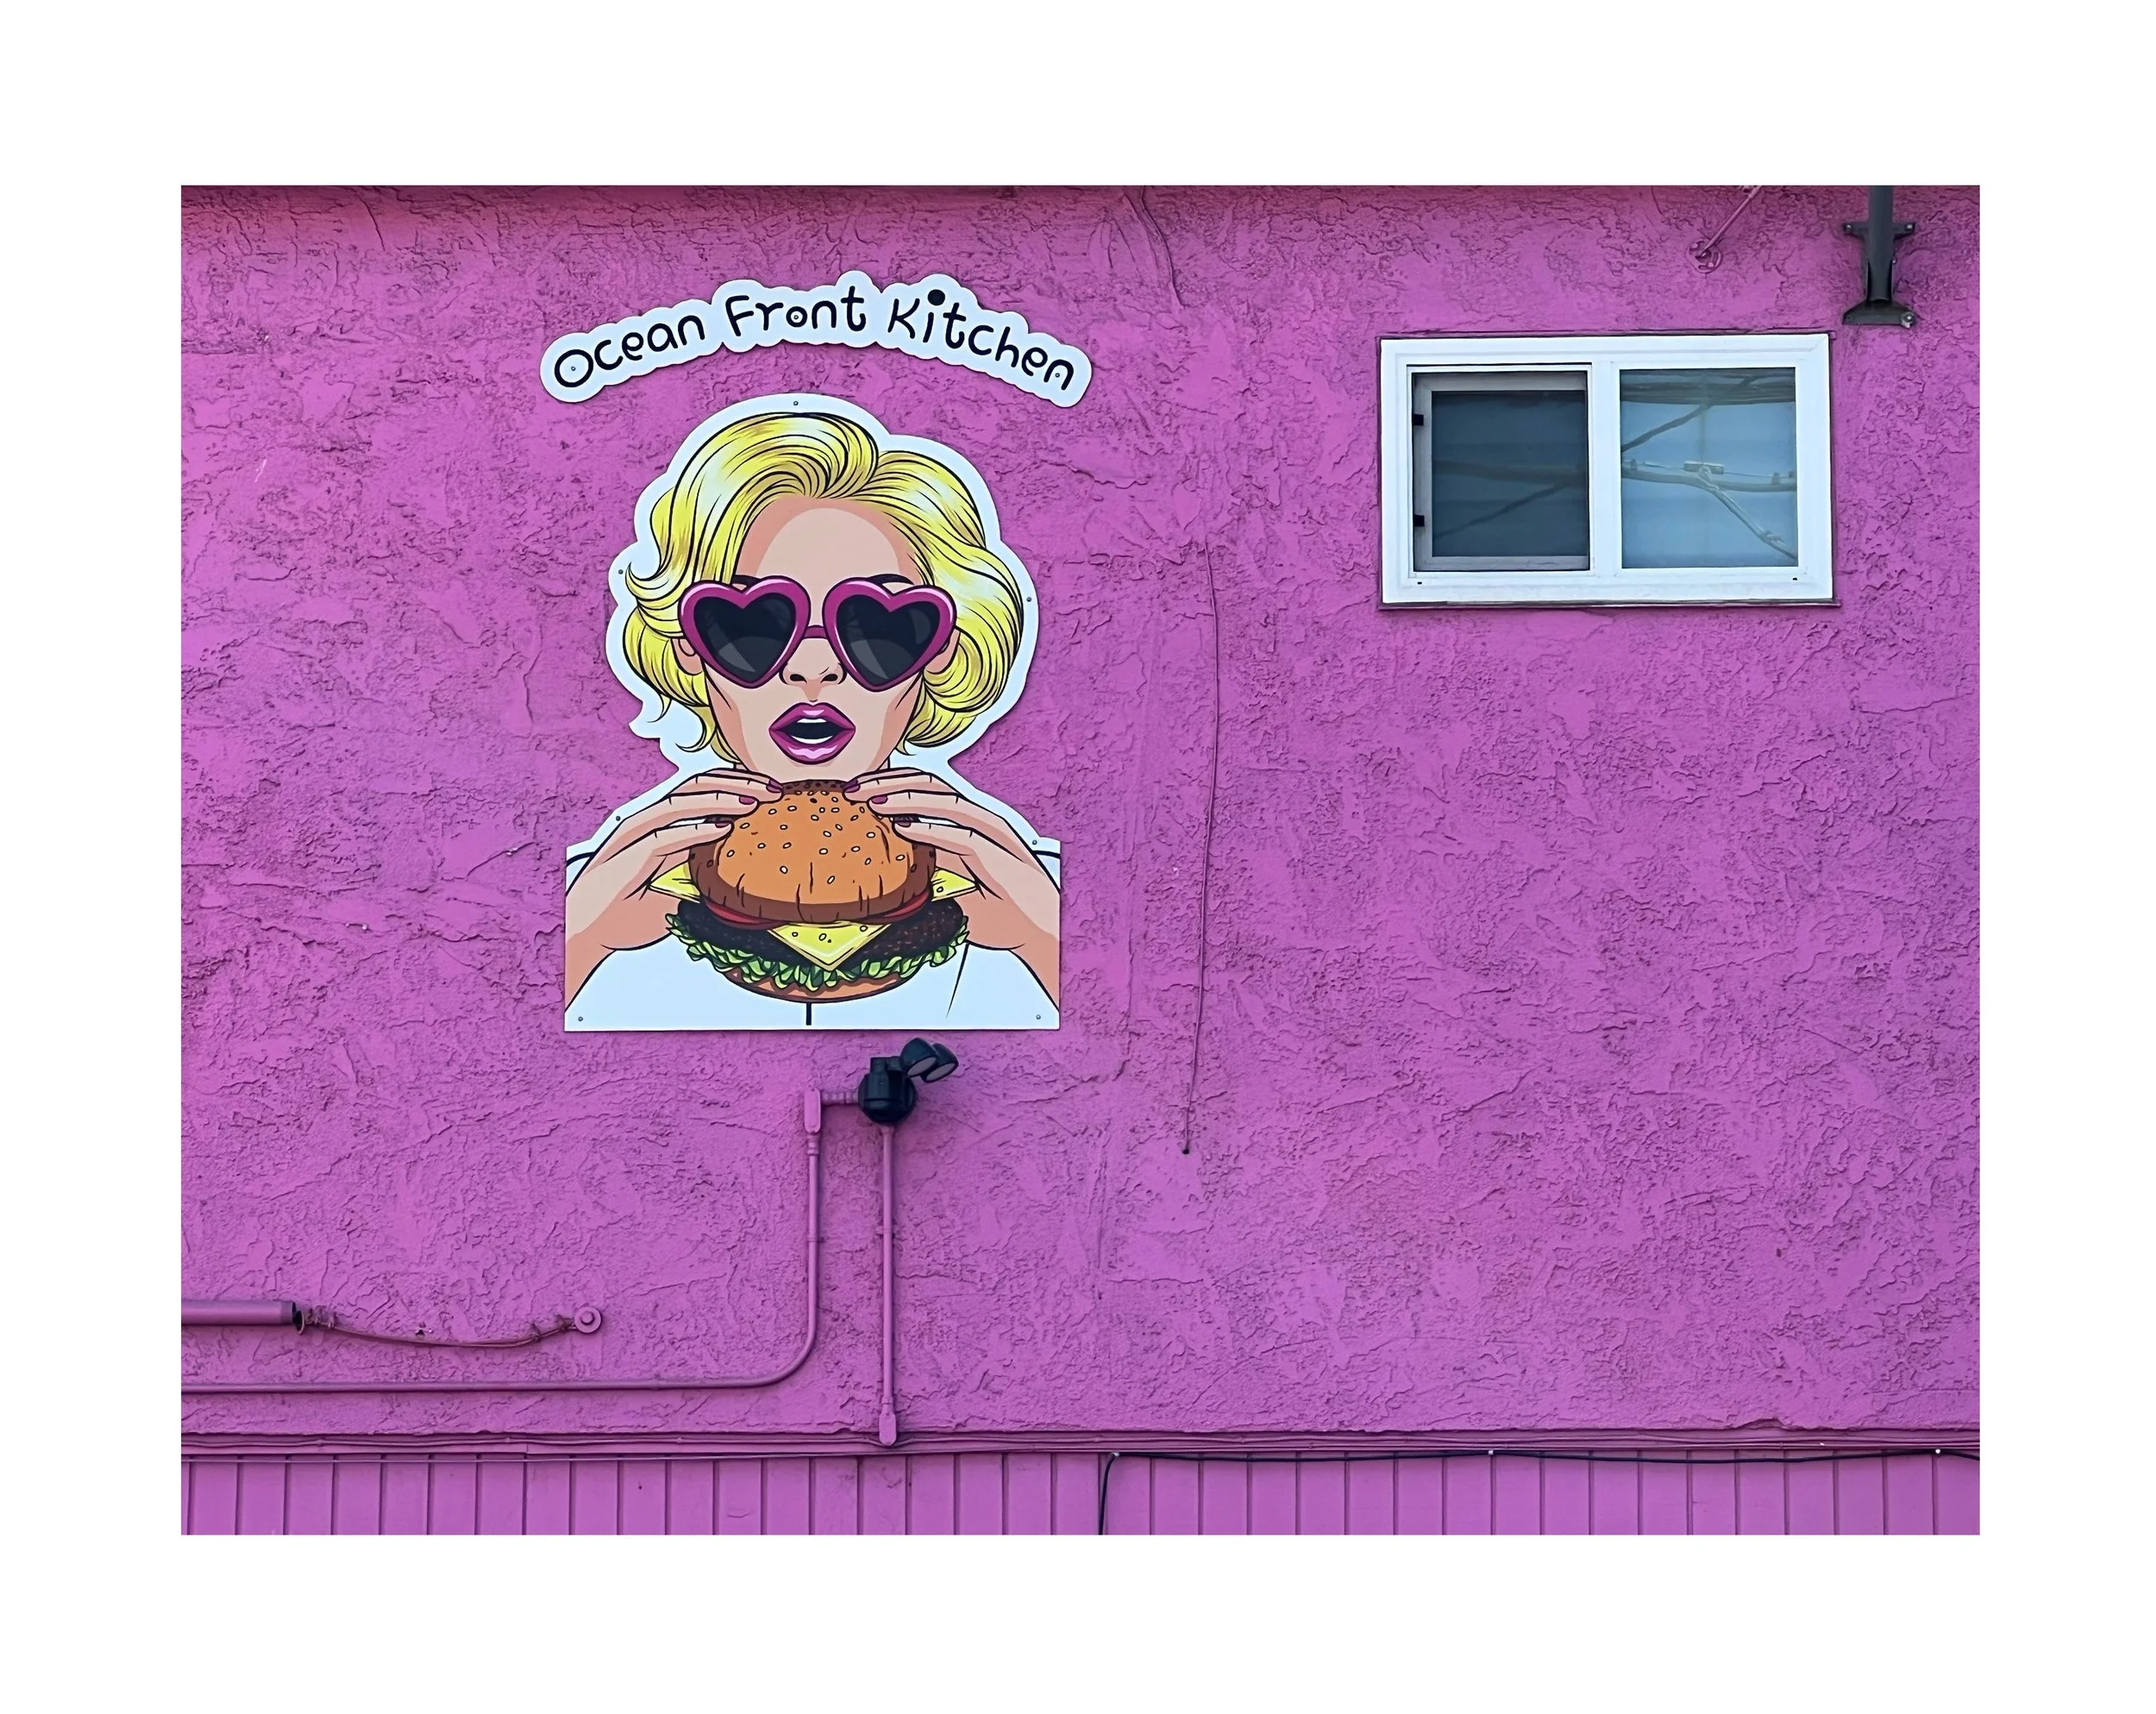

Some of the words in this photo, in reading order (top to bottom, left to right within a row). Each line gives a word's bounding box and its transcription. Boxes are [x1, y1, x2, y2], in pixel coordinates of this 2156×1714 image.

[553, 314, 706, 389] Ocean
[724, 285, 868, 338] Front
[887, 288, 1075, 392] Kitchen
